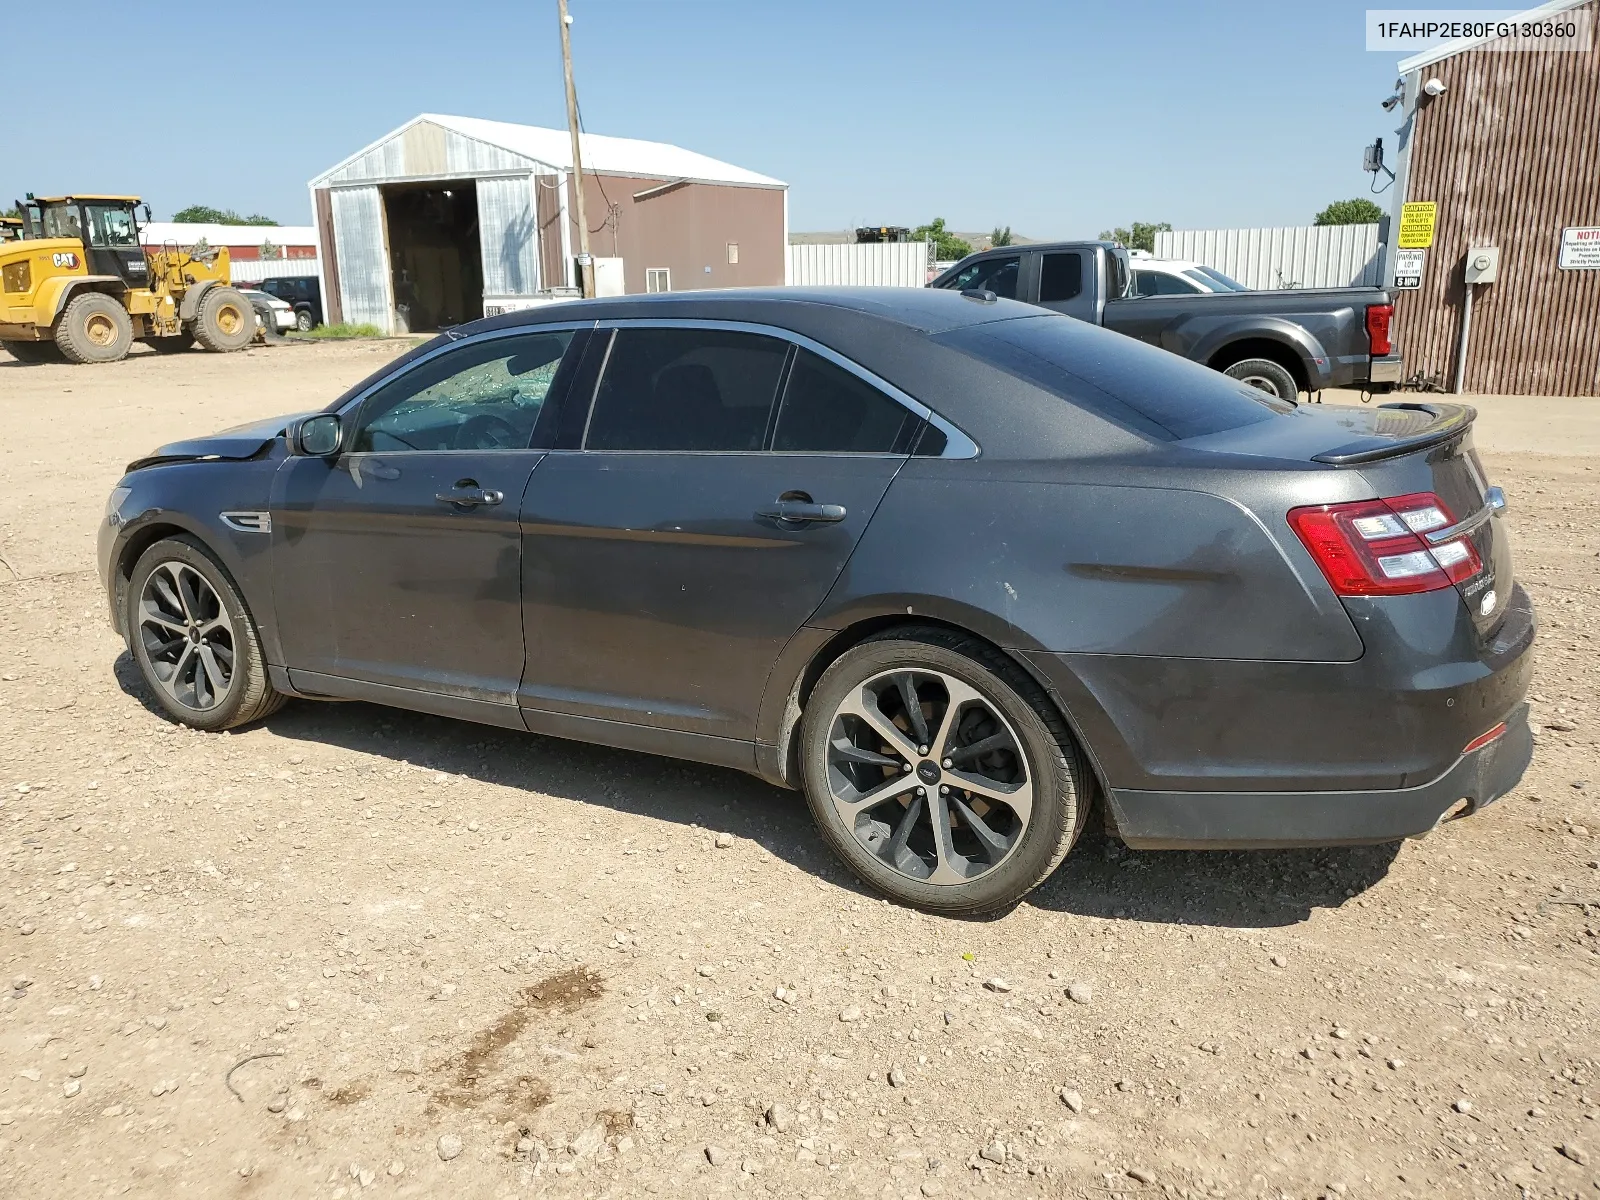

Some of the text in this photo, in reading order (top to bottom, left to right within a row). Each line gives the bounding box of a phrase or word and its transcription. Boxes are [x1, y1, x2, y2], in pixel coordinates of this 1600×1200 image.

[1576, 231, 1600, 240] NOTI
[52, 252, 75, 267] CAT
[1398, 253, 1422, 261] PARKING
[1397, 277, 1418, 286] 5 MPH
